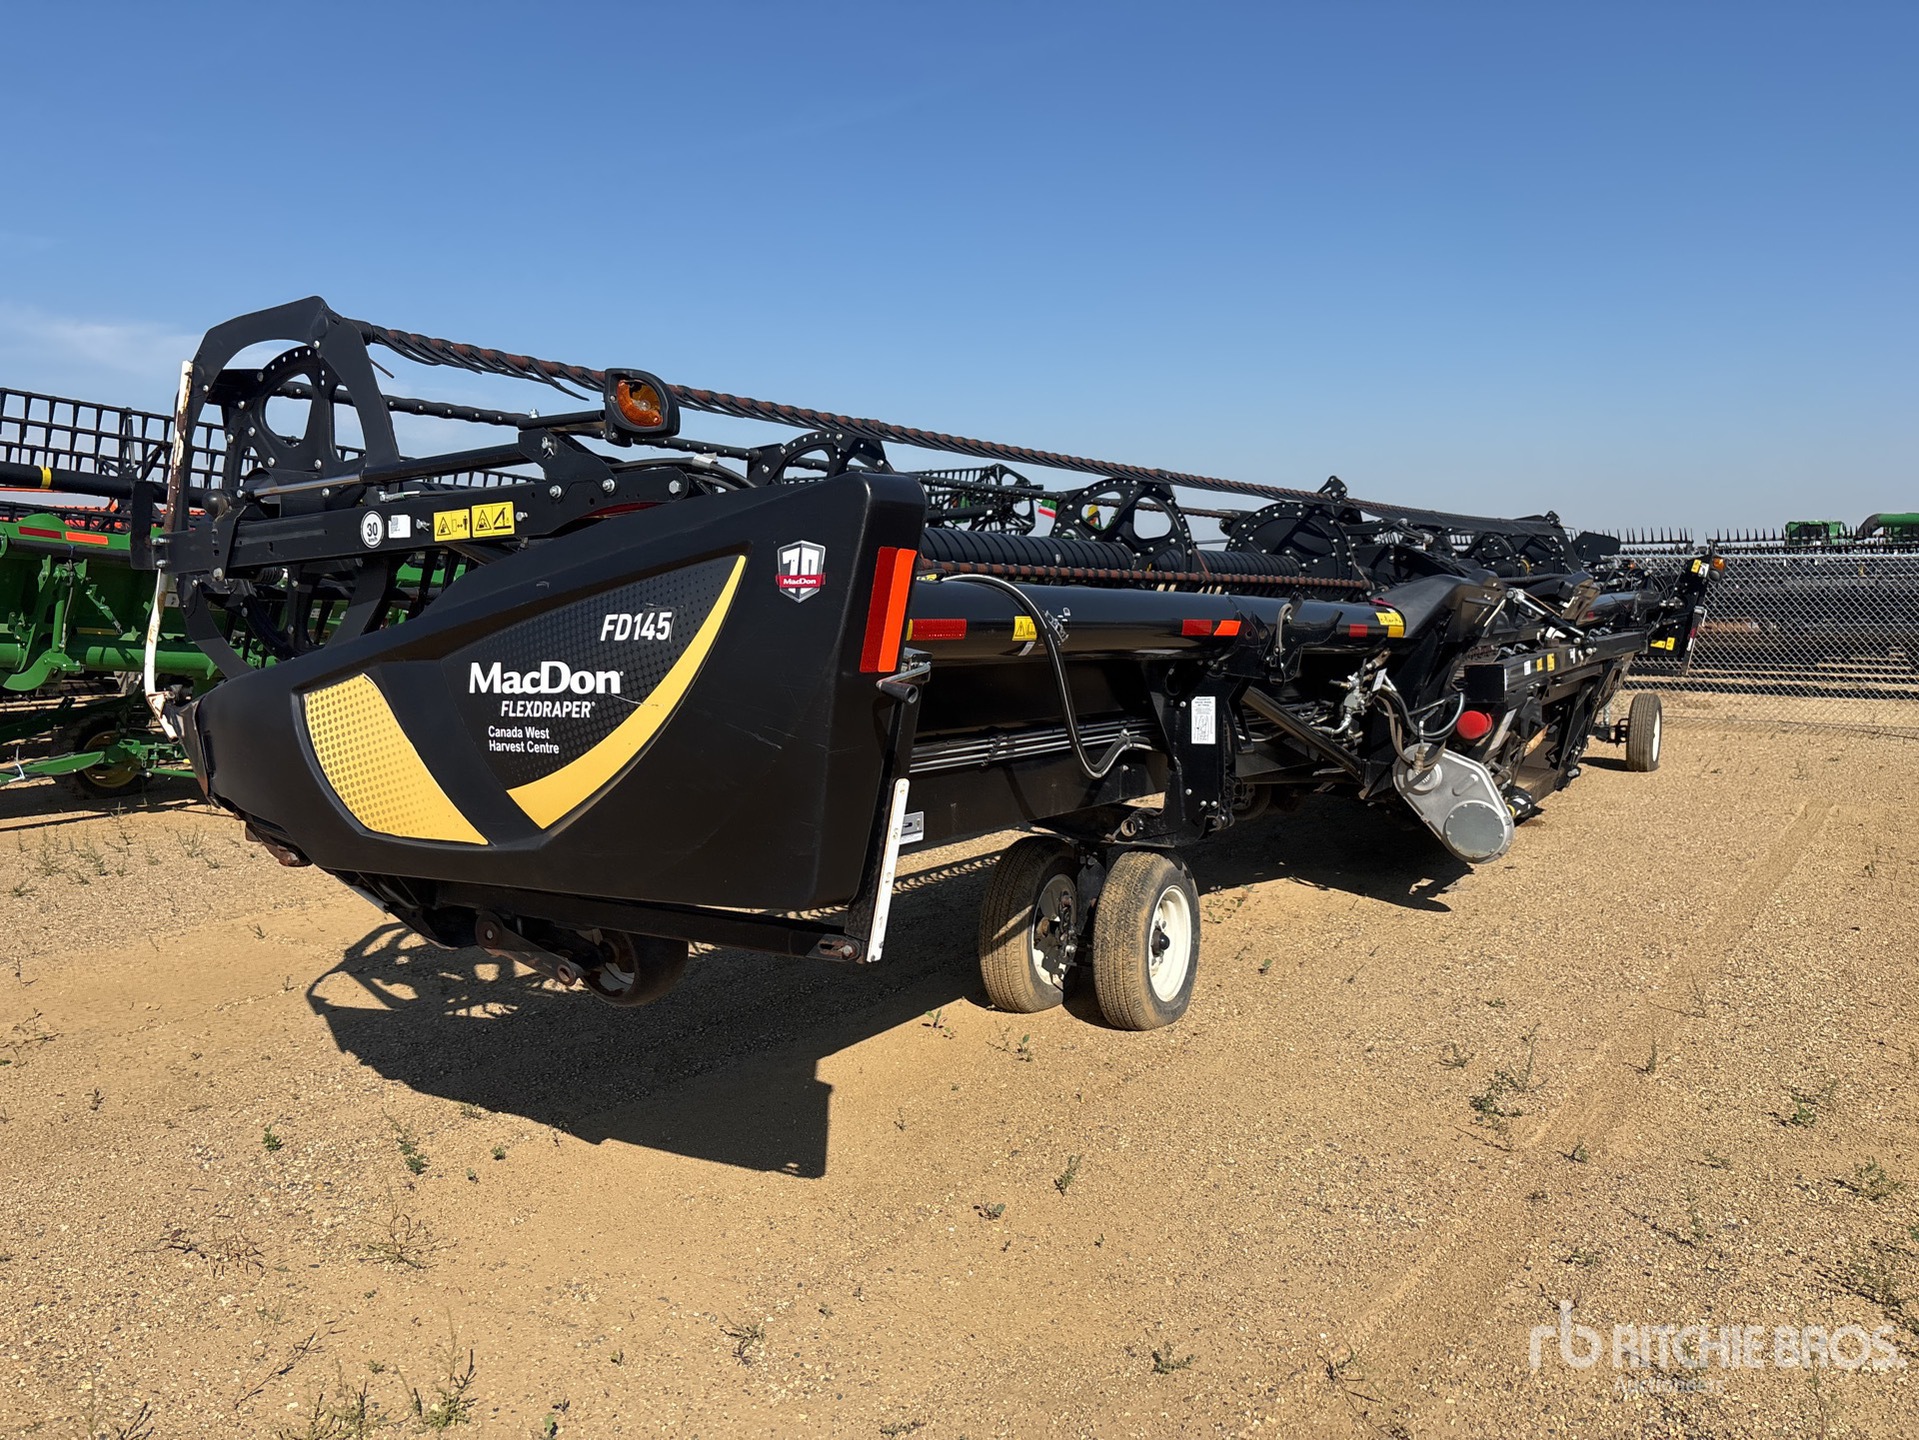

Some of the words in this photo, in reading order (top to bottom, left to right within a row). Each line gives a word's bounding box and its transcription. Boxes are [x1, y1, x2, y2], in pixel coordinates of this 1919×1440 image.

[367, 522, 378, 537] 30
[783, 577, 817, 585] MacDon
[600, 611, 672, 642] FD145
[468, 660, 622, 695] MacDon
[500, 700, 593, 719] FLEXDRAPER
[488, 725, 523, 739] Canada
[525, 726, 550, 739] West
[488, 740, 525, 753] Harvest
[526, 740, 560, 754] Centre
